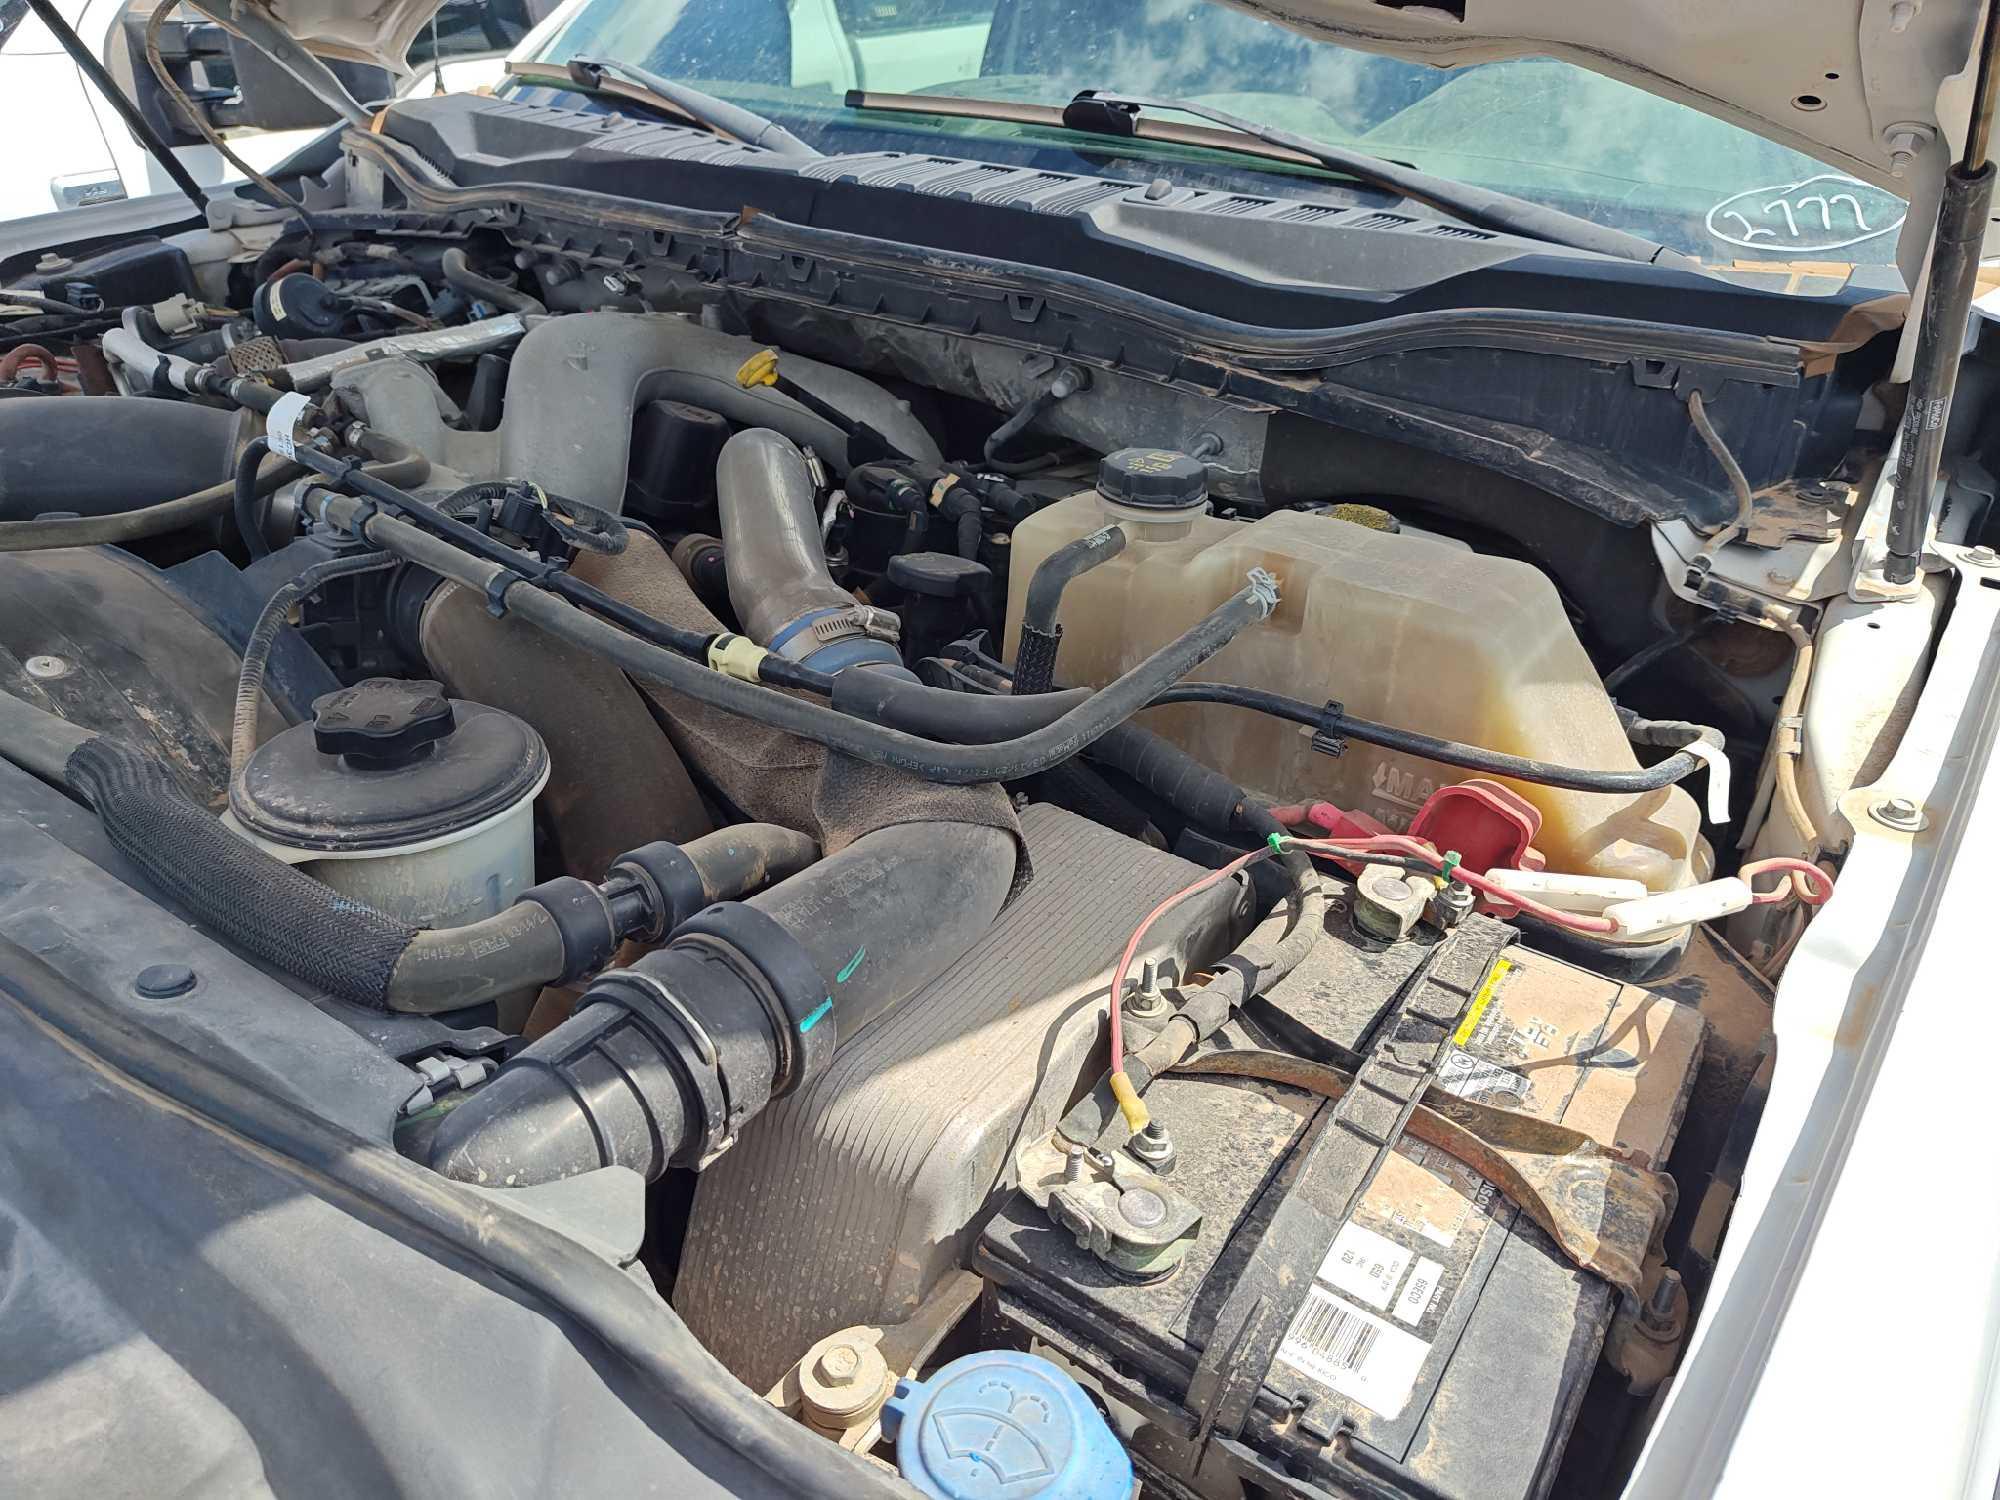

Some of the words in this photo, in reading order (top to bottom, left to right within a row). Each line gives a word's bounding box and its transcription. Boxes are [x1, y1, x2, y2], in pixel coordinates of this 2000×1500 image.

[1723, 193, 1872, 241] 2777
[1387, 767, 1448, 801] MA
[1341, 1249, 1355, 1265] 120
